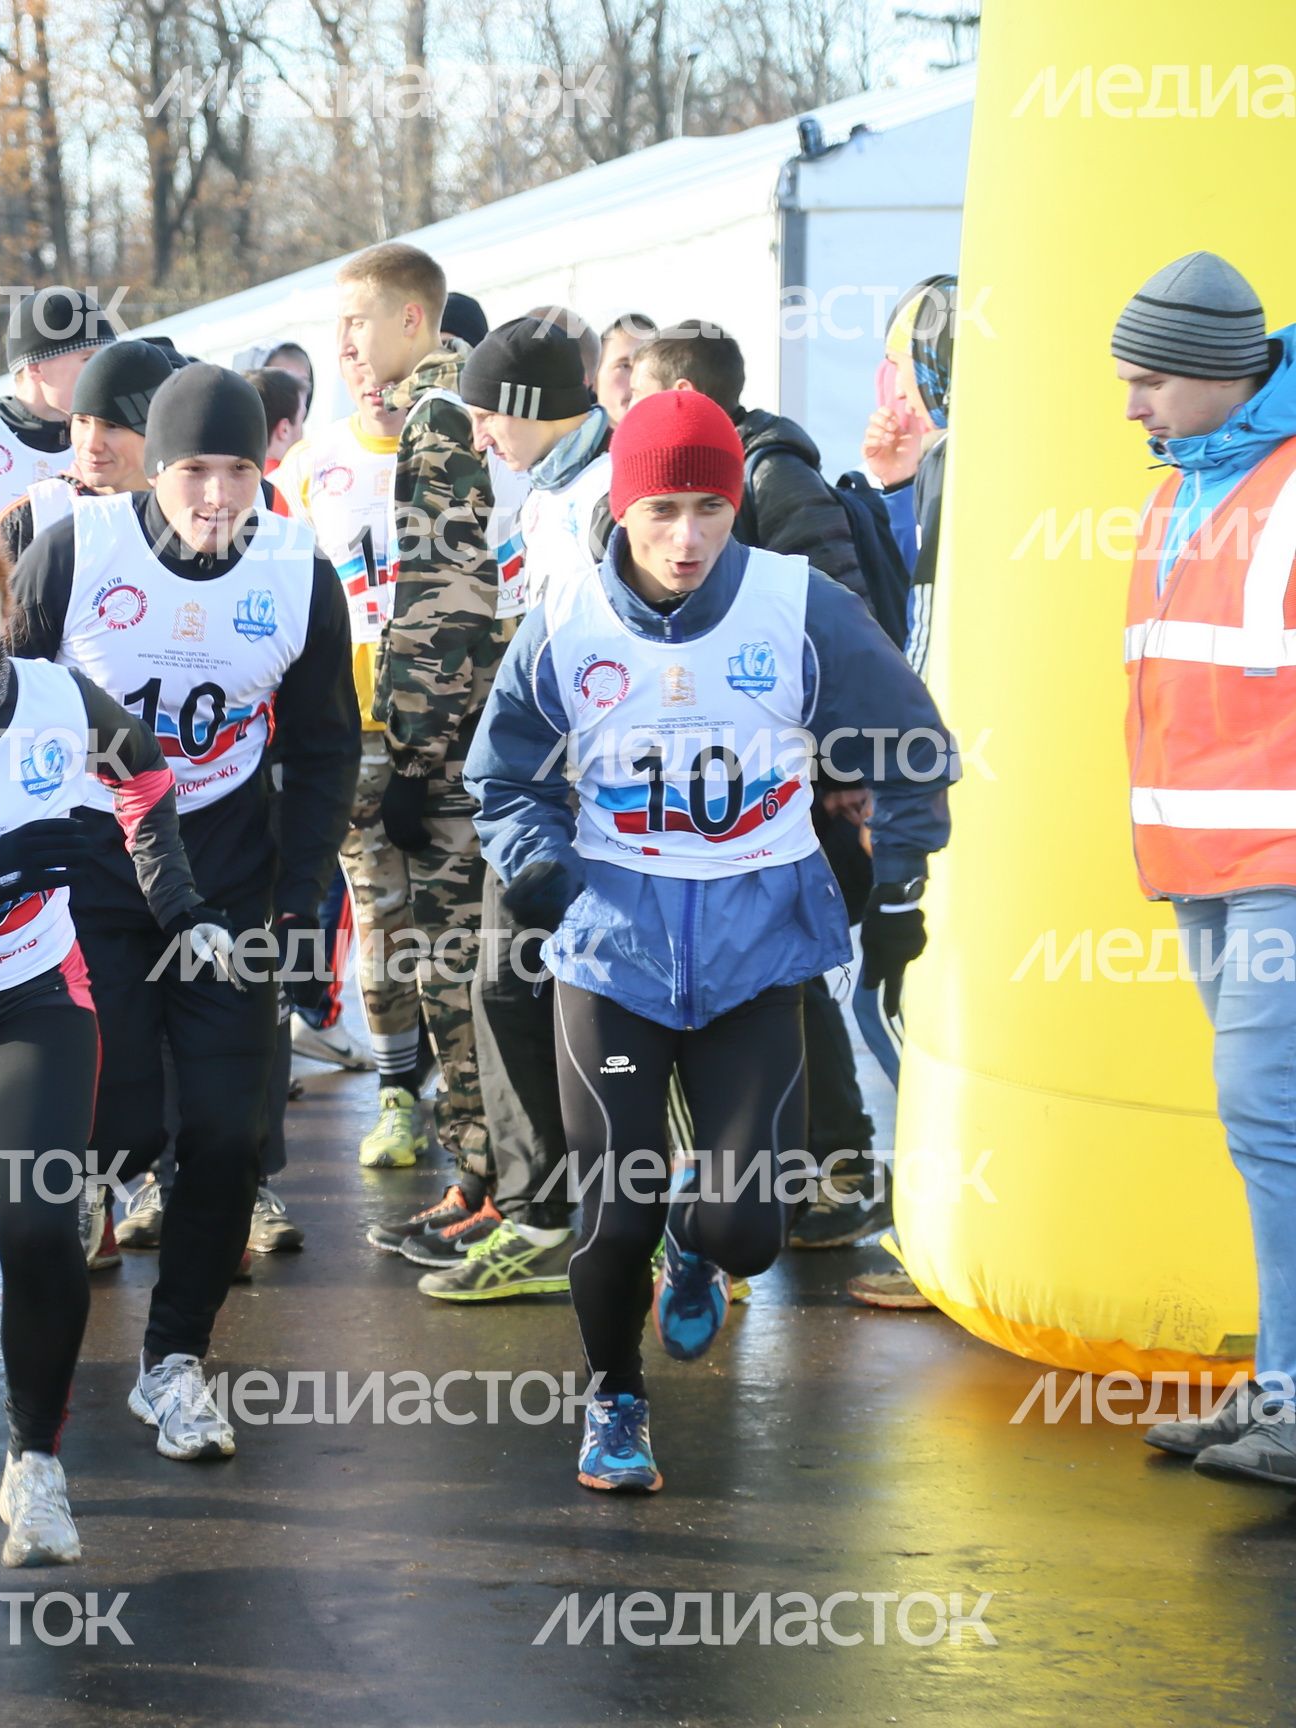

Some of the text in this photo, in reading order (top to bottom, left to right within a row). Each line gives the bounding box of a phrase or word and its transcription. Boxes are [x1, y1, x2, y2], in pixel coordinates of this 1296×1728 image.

[124, 678, 227, 757] 10
[631, 745, 744, 835] 10
[762, 788, 780, 821] 6
